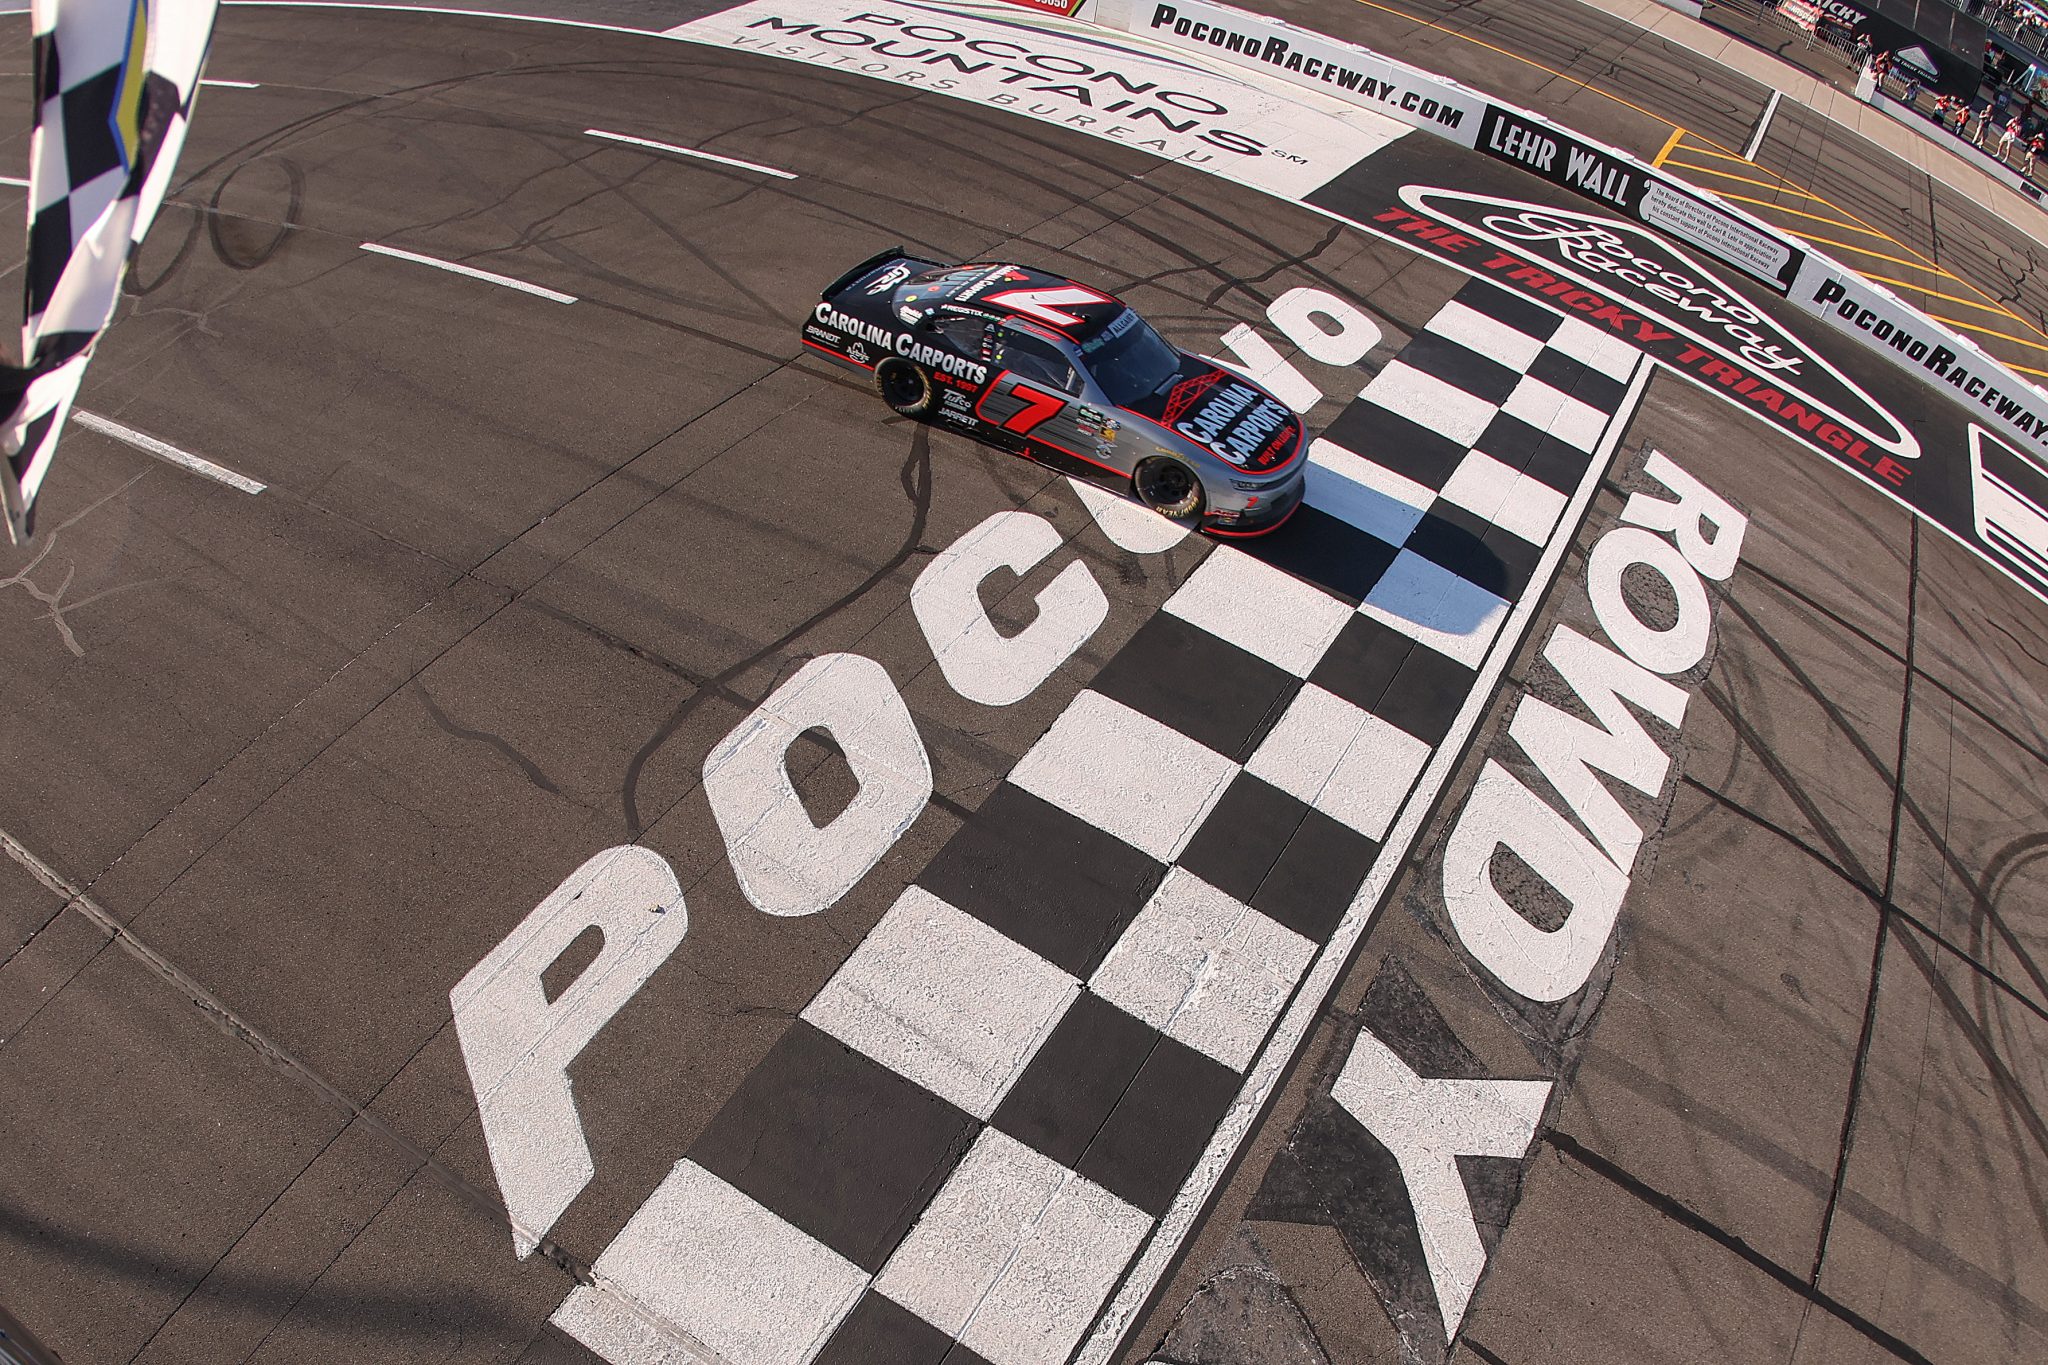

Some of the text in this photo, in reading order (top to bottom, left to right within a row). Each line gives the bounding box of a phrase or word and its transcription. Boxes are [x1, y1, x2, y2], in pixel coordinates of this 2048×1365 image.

[1035, 0, 1068, 8] 050
[1808, 0, 1868, 25] ICKY
[732, 36, 1213, 162] VISITORS BUREAU
[744, 17, 1269, 156] MOUNTAINS
[842, 13, 1229, 115] POCONO
[1150, 3, 1464, 129] POCONORACEWAY.COM
[1489, 115, 1631, 207] LEHR WALL
[1651, 195, 1666, 208] hereby
[1667, 204, 1687, 216] dedicate
[1687, 213, 1696, 221] this
[1696, 218, 1706, 227] wall
[1712, 225, 1722, 234] Carl
[1727, 233, 1738, 242] Lehr
[1744, 242, 1772, 260] appreciation
[1652, 205, 1660, 213] his
[1660, 210, 1680, 223] constant
[1680, 219, 1697, 232] support
[1703, 230, 1721, 244] Pocono
[1720, 239, 1750, 258] International
[1750, 253, 1769, 269] Raceway
[1656, 188, 1664, 196] The
[1665, 192, 1679, 204] Board
[1685, 202, 1706, 217] Directors
[1712, 215, 1730, 229] Pocono
[1730, 224, 1759, 244] International
[1759, 239, 1779, 255] Raceway
[1482, 212, 1760, 325] Pocono
[1555, 234, 1804, 376] Raceway
[814, 302, 893, 351] CAROLINA
[895, 333, 988, 386] CARPORTS
[1373, 206, 1912, 487] THE TRICKY TRIANGLE
[938, 407, 980, 426] JARRETT
[1002, 384, 1067, 434] 7
[1176, 383, 1260, 443] CAROLINA
[1209, 398, 1290, 465] CARPORTS
[449, 286, 1382, 1259] POCNO
[1330, 448, 1749, 1344] ROWDY
